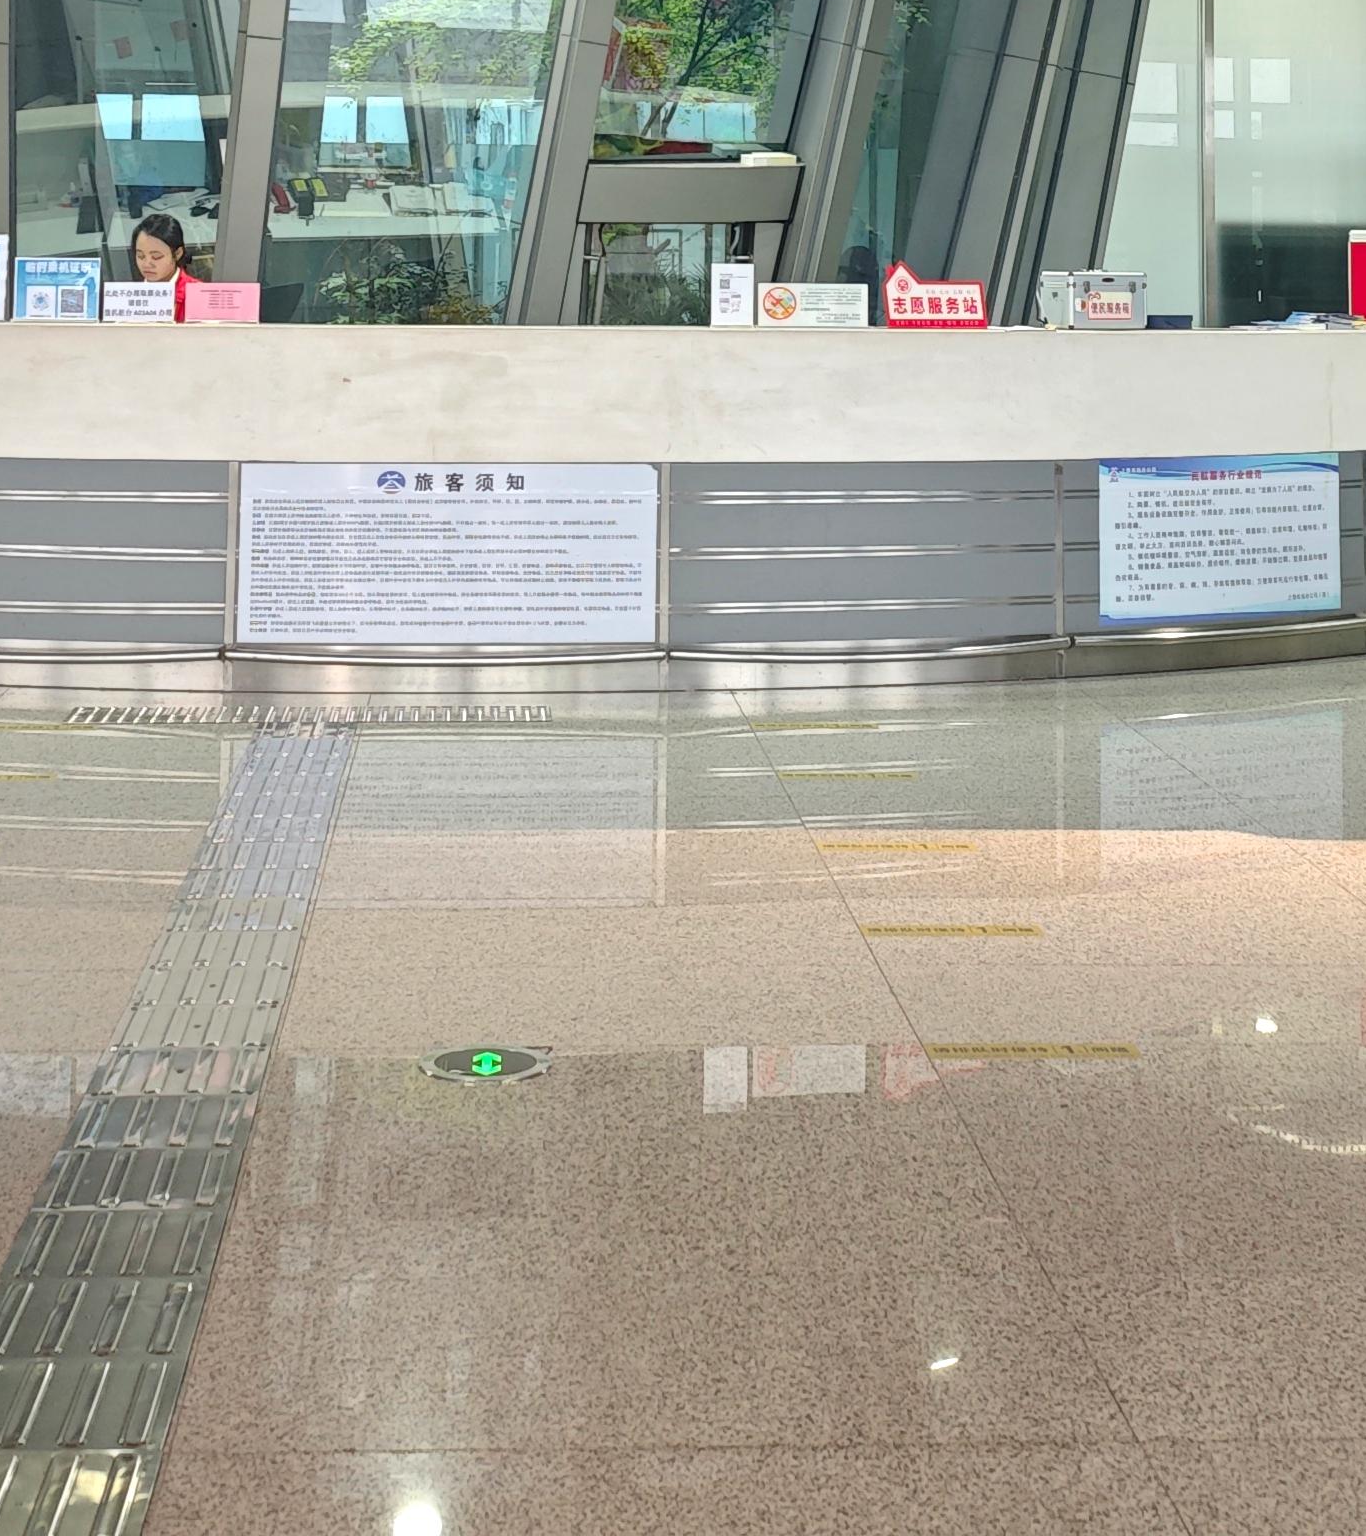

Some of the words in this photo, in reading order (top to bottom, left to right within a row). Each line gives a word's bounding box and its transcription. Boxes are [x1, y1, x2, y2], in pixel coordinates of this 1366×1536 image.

[892, 296, 978, 314] 志愿服务站
[414, 472, 525, 492] 旅客须知
